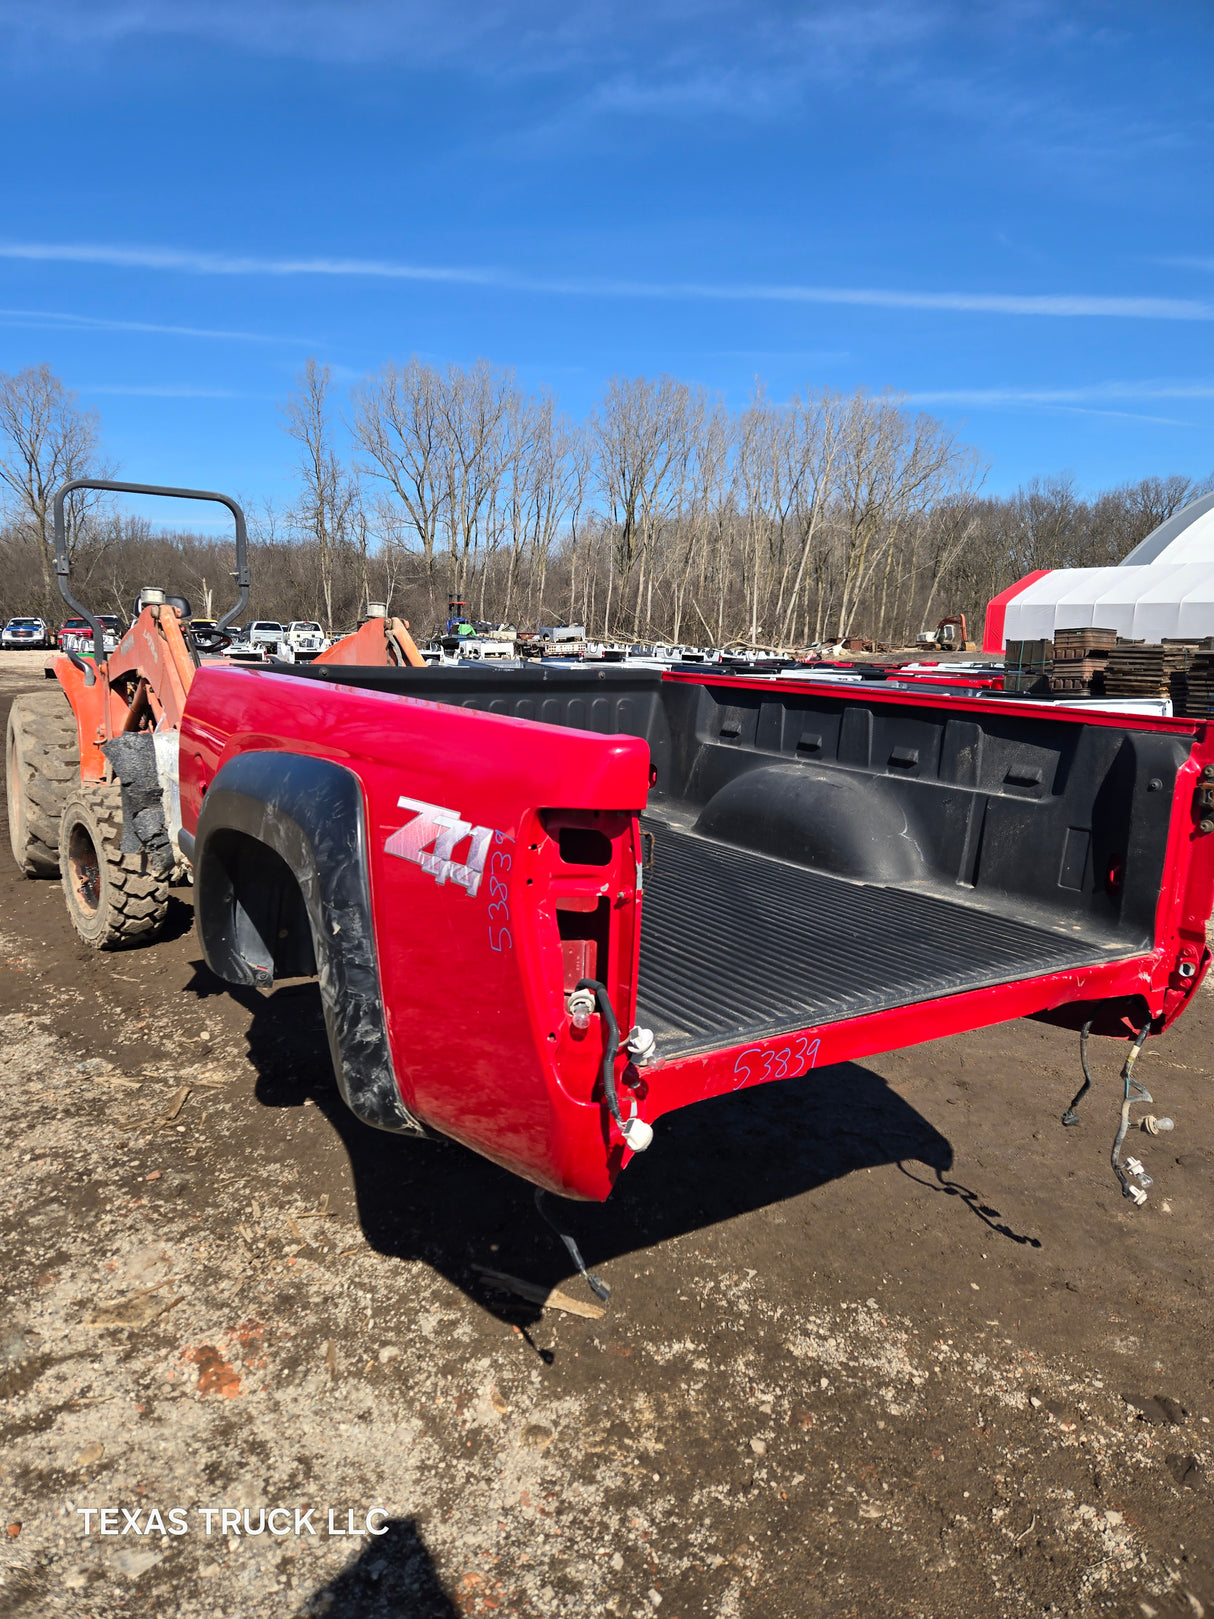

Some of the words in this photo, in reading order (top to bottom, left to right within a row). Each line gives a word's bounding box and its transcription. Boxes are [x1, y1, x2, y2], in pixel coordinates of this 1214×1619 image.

[383, 795, 494, 873] Z71
[487, 829, 516, 951] 53839
[732, 1037, 821, 1091] 53839
